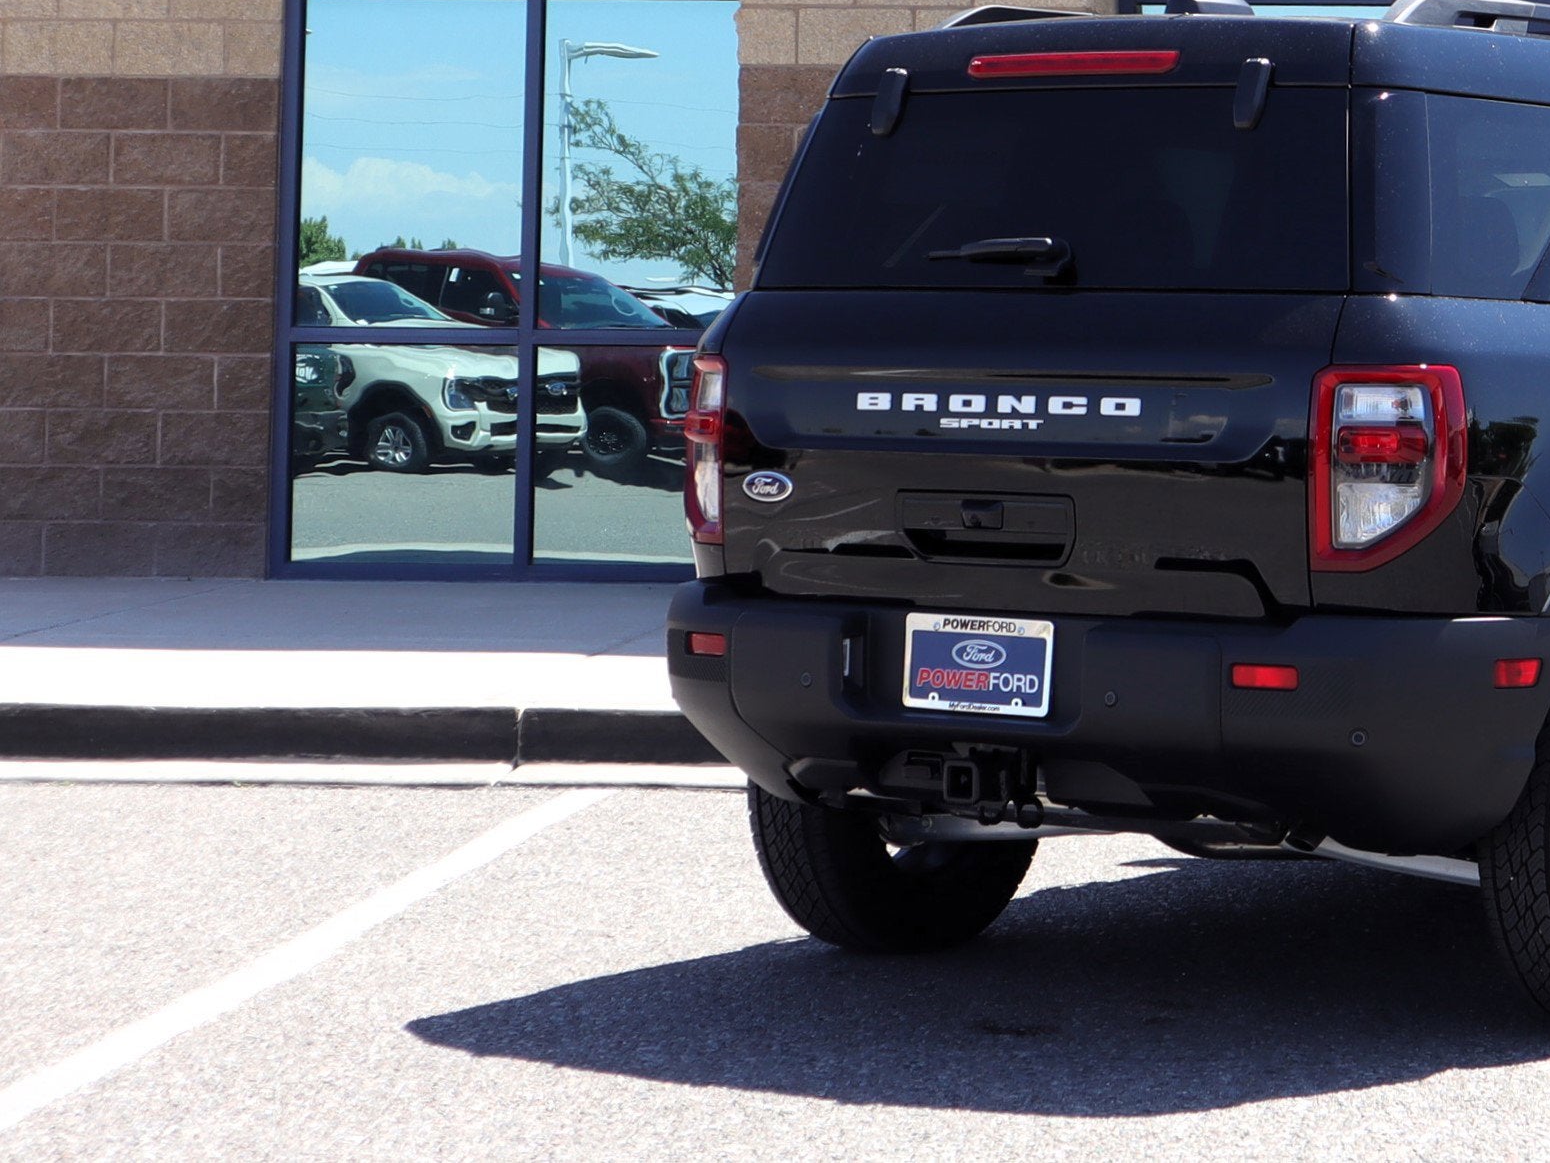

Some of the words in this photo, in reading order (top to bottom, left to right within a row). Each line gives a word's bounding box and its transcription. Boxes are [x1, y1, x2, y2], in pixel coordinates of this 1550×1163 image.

[857, 392, 1142, 417] BRONCO
[940, 418, 1044, 430] SPORT
[752, 477, 779, 495] Ford
[942, 618, 1016, 633] POWERFORD
[962, 644, 995, 662] Ford
[916, 668, 1039, 693] POWERFORD
